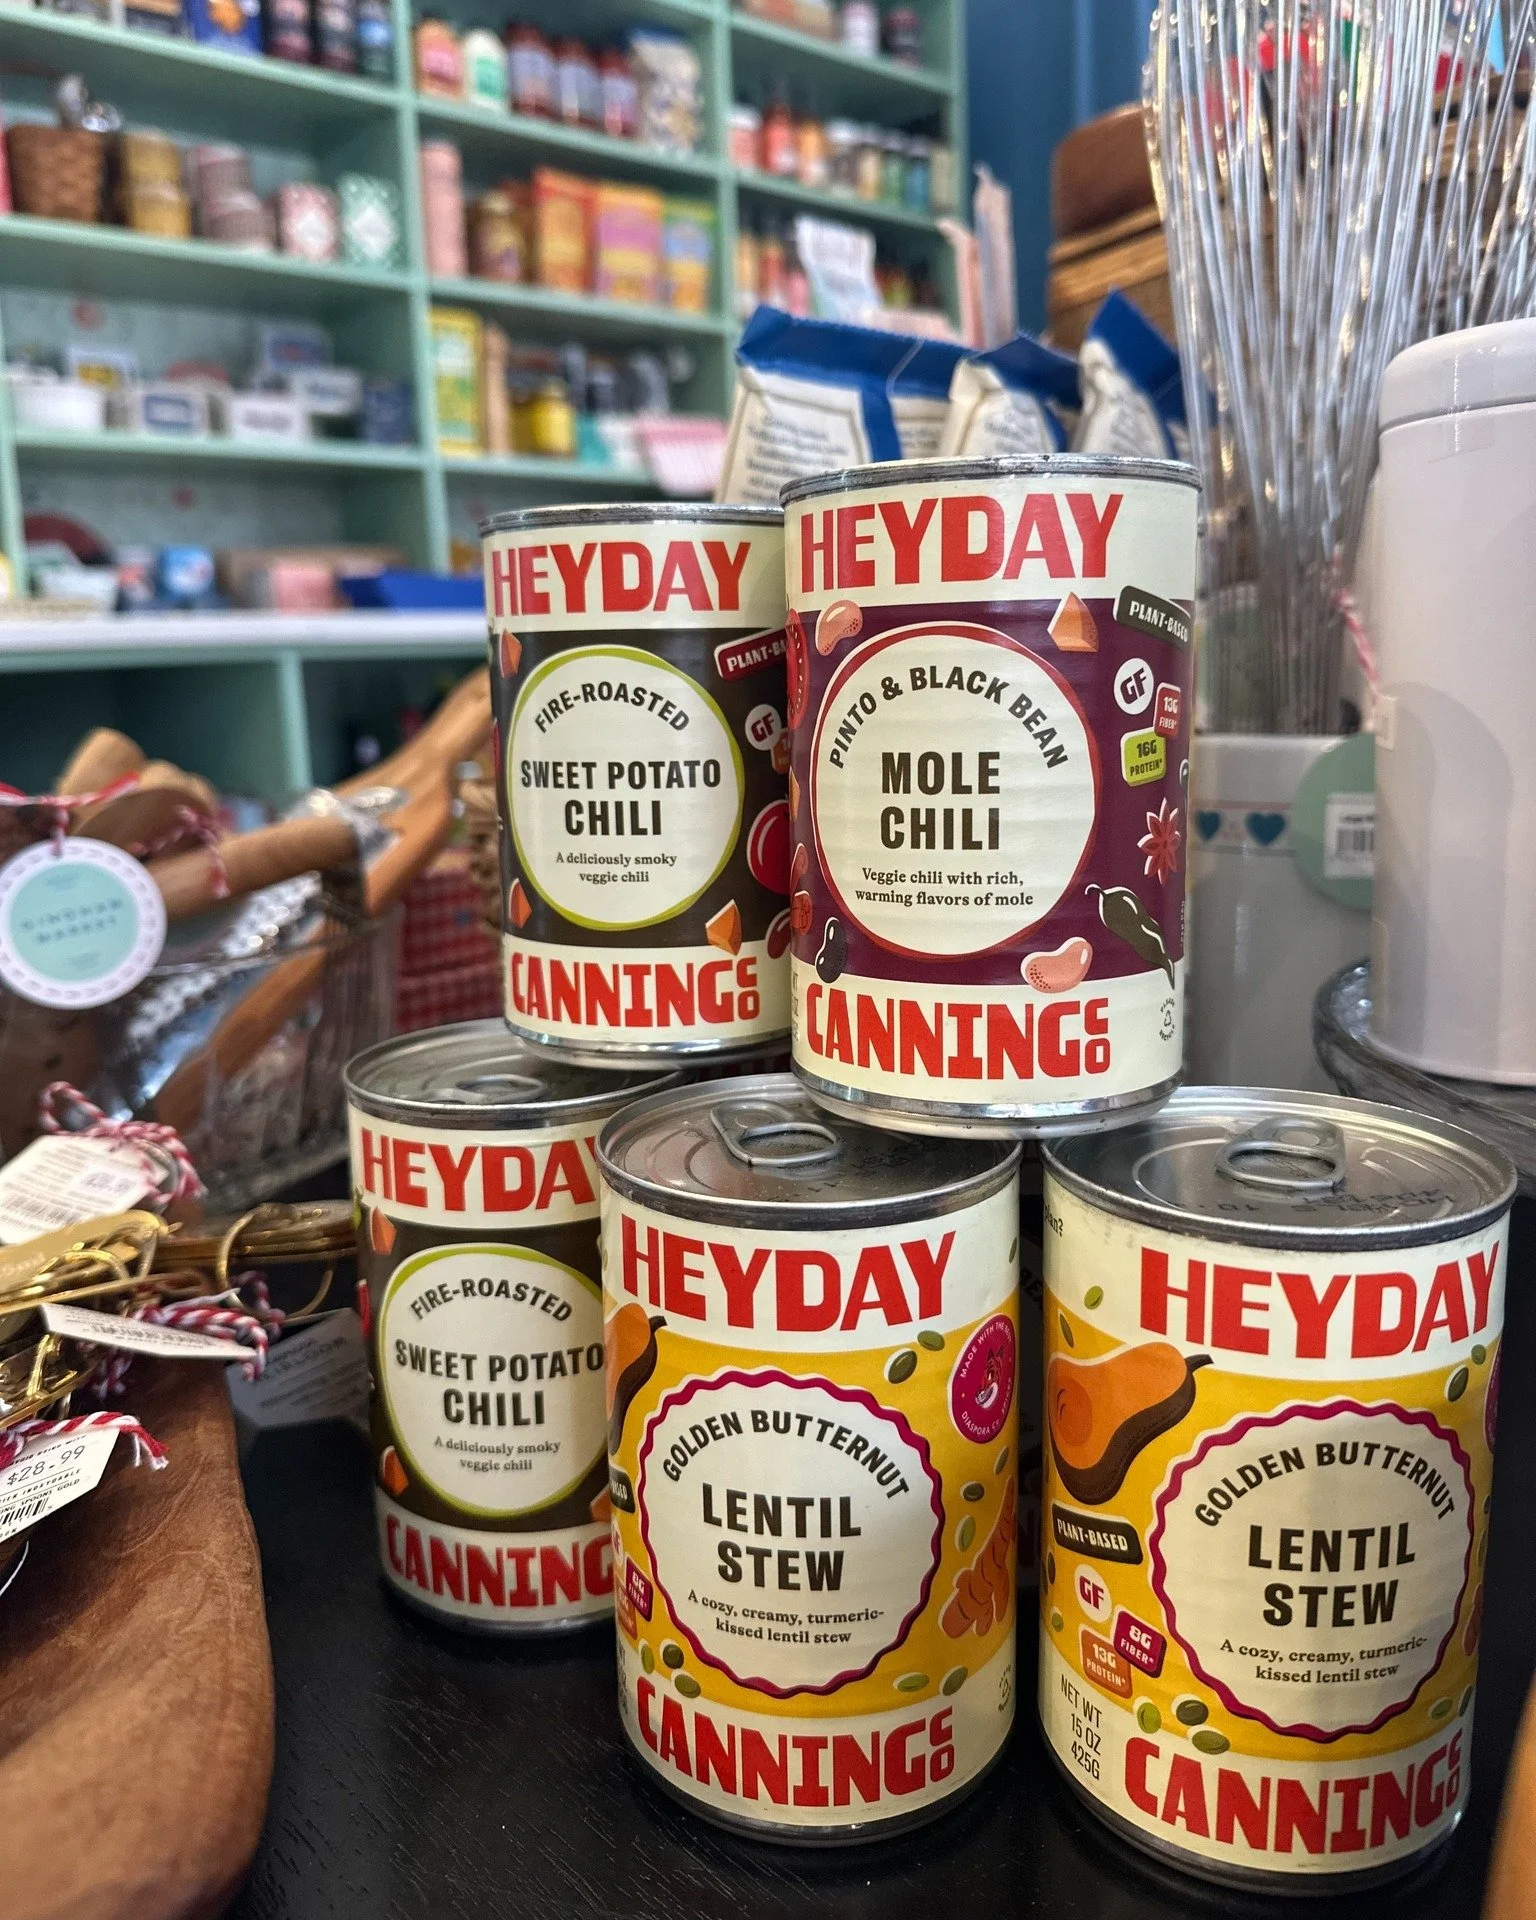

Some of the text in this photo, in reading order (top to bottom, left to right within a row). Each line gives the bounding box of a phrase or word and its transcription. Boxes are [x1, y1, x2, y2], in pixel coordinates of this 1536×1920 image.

[801, 494, 1124, 593] HEYDAY
[492, 541, 751, 617] HEYDAY
[1129, 601, 1188, 642] PLANT-BASED
[727, 639, 786, 672] PLANT-BA
[1120, 668, 1146, 704] GF
[534, 681, 690, 733] FIRE-ROASTED
[751, 712, 776, 743] GF
[830, 693, 877, 769] PINTO
[880, 676, 903, 700] &
[910, 665, 1010, 705] BLACK
[1008, 693, 1068, 769] BEAN
[1137, 740, 1156, 759] 16G
[521, 759, 721, 790] SWEET POTATO
[881, 752, 1000, 795] MOLE
[564, 799, 662, 836] CHILI
[880, 806, 1000, 850] CHILI
[556, 852, 677, 867] A deliciously smoky
[579, 870, 650, 885] veggie chili
[862, 868, 1023, 886] Veggie chili with rich,
[855, 889, 1033, 907] warming flavors of mole
[512, 952, 734, 1027] CANNING
[807, 983, 1080, 1080] CANNING
[362, 1127, 597, 1212] HEYDA
[621, 1213, 956, 1332] HEYDAY
[410, 1277, 573, 1322] FIRE-ROASTED
[1140, 1239, 1500, 1359] HEYDAY
[395, 1339, 478, 1381] SWEET
[489, 1342, 604, 1382] POTATO
[960, 1346, 978, 1378] MADE
[978, 1326, 994, 1345] WITH
[444, 1388, 545, 1426] CHILI
[961, 1410, 990, 1436] DIASPORA
[7, 1445, 85, 1485] $28.99
[435, 1436, 562, 1455] A deliciously smoky
[459, 1458, 533, 1472] veggie chili
[663, 1409, 909, 1499] GOLDEN BUTTERNUT
[57, 1478, 80, 1491] GOLD
[1194, 1441, 1454, 1527] GOLDEN BUTTERNUT
[702, 1482, 861, 1539] LENTIL
[1057, 1518, 1129, 1551] PLANT-BASED
[1248, 1522, 1416, 1572] LENTIL
[386, 1512, 614, 1607] CANNING
[717, 1540, 845, 1592] STEW
[688, 1589, 885, 1626] A cozy, creamy, turmeric-
[1079, 1575, 1104, 1610] GF
[1262, 1579, 1399, 1628] STEW
[715, 1617, 852, 1644] kissed lentil stew
[1129, 1625, 1151, 1649] 8G
[1220, 1636, 1428, 1665] A cozy, creamy, turmeric-
[1092, 1643, 1117, 1669] 13G
[1256, 1664, 1400, 1683] kissed lentil stew
[1061, 1674, 1103, 1730] NET WT
[637, 1675, 926, 1807] CANNING
[1071, 1712, 1101, 1756] 15 OZ
[1071, 1741, 1100, 1781] 425G
[1125, 1737, 1447, 1855] CANNING
